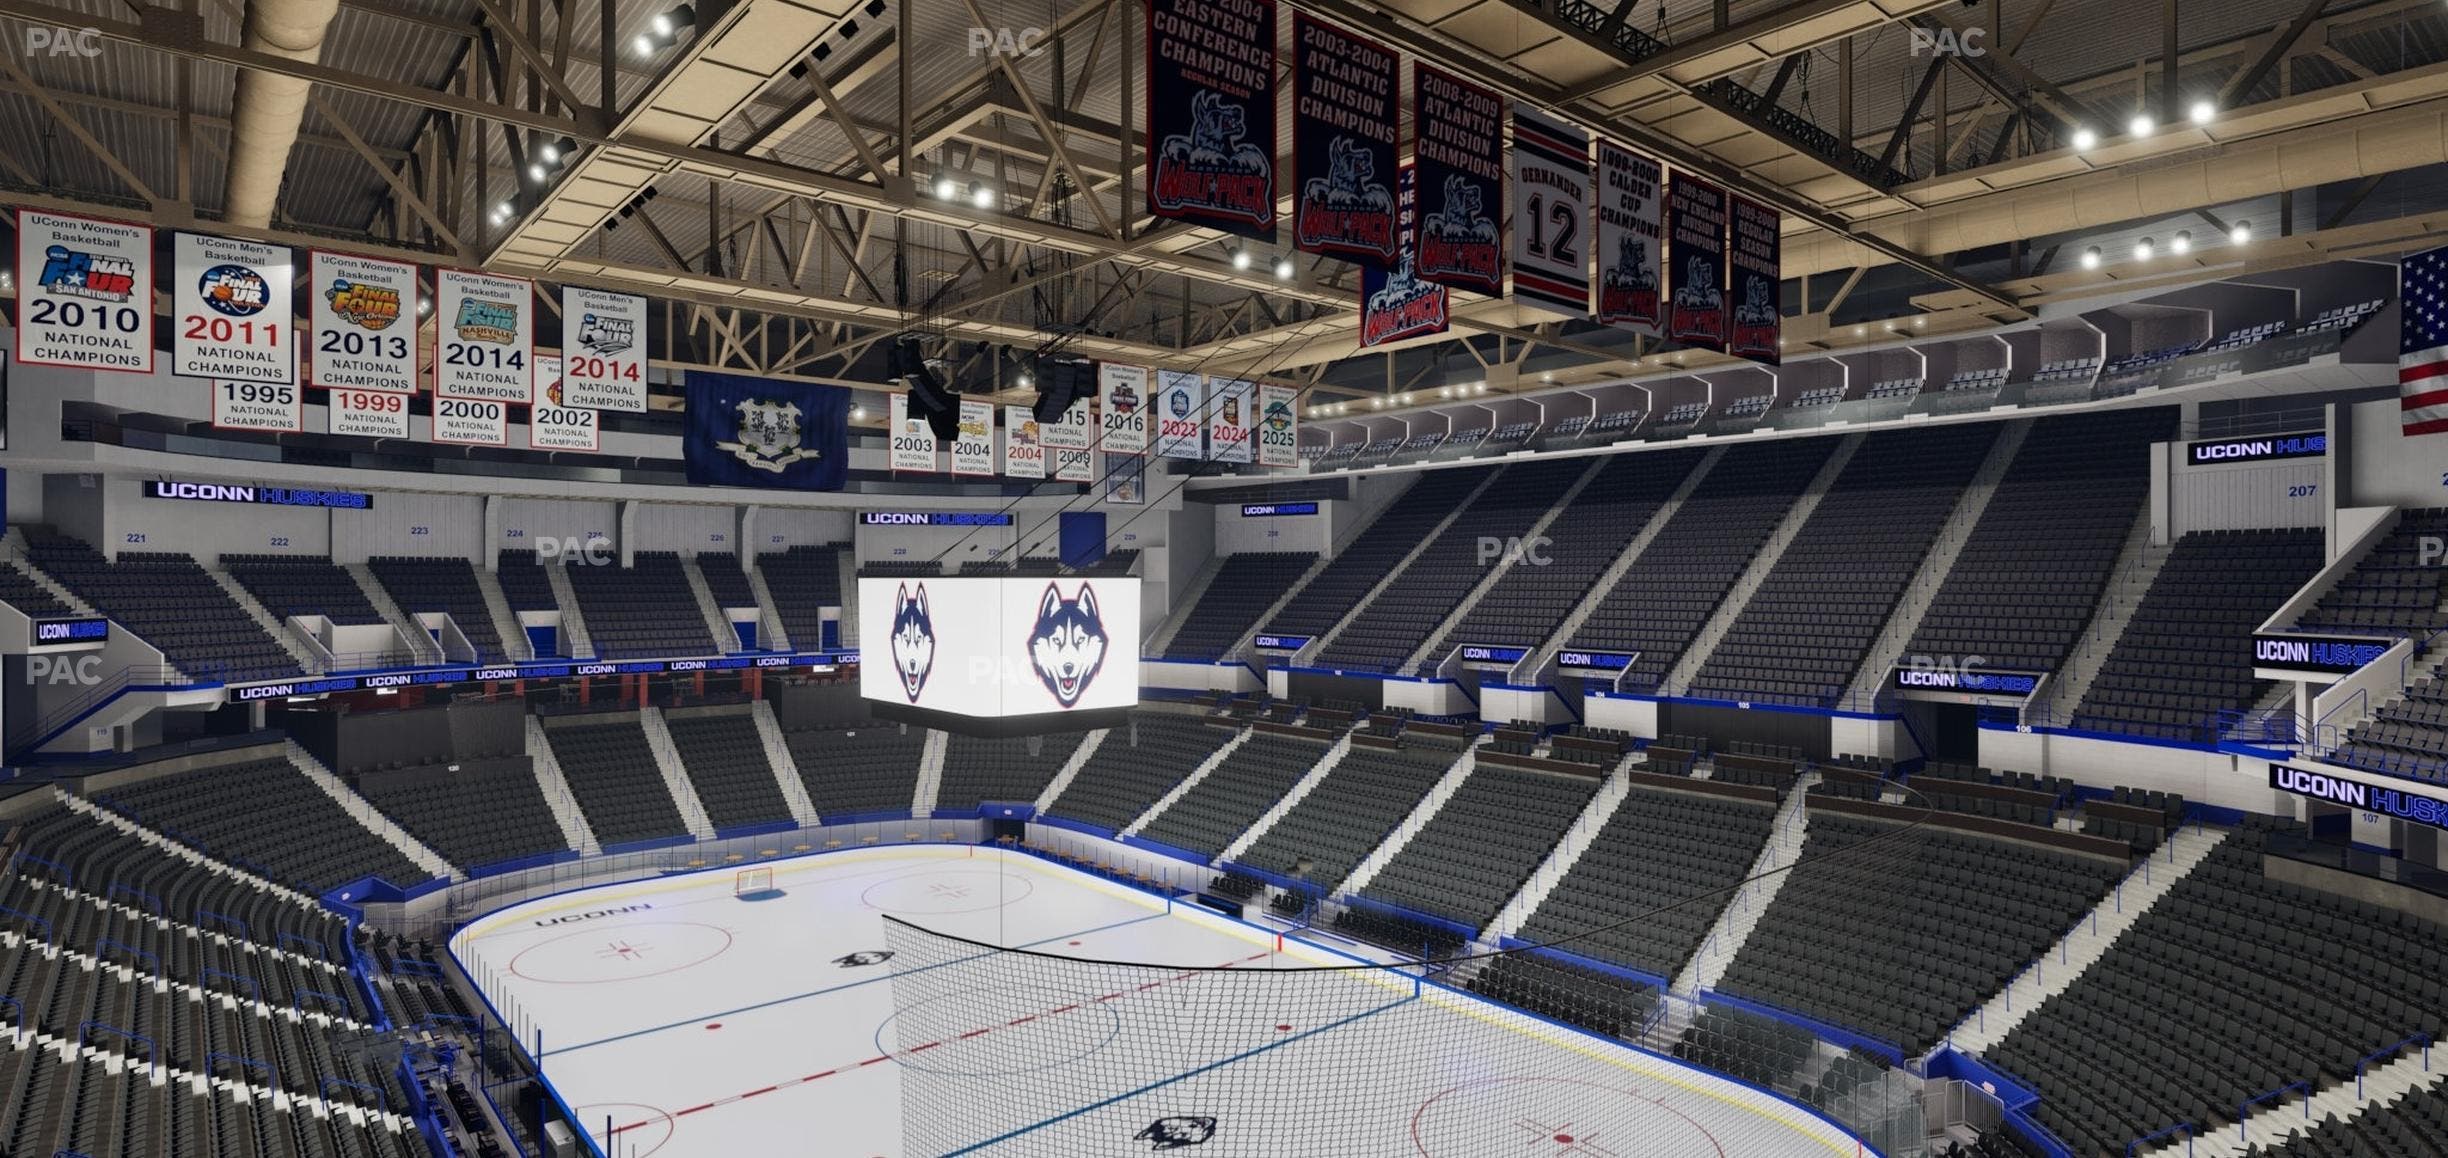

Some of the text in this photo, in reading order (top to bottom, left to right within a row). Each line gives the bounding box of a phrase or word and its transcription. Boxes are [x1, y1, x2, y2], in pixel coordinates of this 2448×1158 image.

[1174, 0, 1257, 42] EASTERN
[1153, 11, 1271, 70] CONFERENCE
[1304, 25, 1391, 75] 2003-2004
[1161, 38, 1266, 91] CHAMPIONS
[1307, 50, 1389, 96] ATLANTIC
[1311, 75, 1384, 117] DIVISION
[1423, 74, 1498, 118] 2008-2009
[1300, 96, 1395, 144] CHAMPIONS
[1424, 96, 1494, 136] ATLANTIC
[1428, 119, 1490, 156] DIVISION
[1419, 137, 1500, 180] CHAMPIONS
[1609, 170, 1652, 200] CALDER
[1620, 193, 1641, 214] CUP
[31, 216, 140, 238] UConn Women's
[1527, 192, 1578, 269] 12
[1600, 206, 1660, 239] CHAMPIONS
[52, 231, 120, 248] Basketball
[196, 238, 272, 255] UConn Men's
[205, 250, 265, 265] Basketball
[321, 256, 408, 275] UConn Women's
[220, 274, 262, 291] FINAL
[337, 269, 392, 284] Basketball
[446, 273, 524, 290] UConn Women's
[55, 284, 120, 301] SAN ANTONIO
[352, 285, 398, 303] FINAL
[461, 286, 510, 299] Basketball
[578, 290, 633, 304] UConn Men's
[335, 291, 398, 317] FOUR
[584, 302, 627, 313] Basketball
[30, 299, 140, 333] 2010
[596, 317, 633, 332] FINAL
[184, 315, 277, 347] 2011
[463, 327, 510, 339] NASHVILLE
[44, 332, 133, 349] NATIONAL
[321, 330, 408, 359] 2013
[34, 347, 142, 366] CHAMPIONS
[197, 346, 275, 363] NATIONAL
[446, 343, 524, 371] 2014
[188, 361, 283, 379] CHAMPIONS
[332, 359, 402, 374] NATIONAL
[570, 356, 640, 382] 2014
[323, 373, 409, 389] CHAMPIONS
[456, 371, 519, 385] NATIONAL
[224, 383, 293, 405] 1995
[449, 384, 525, 399] CHAMPIONS
[579, 382, 635, 396] NATIONAL
[339, 392, 401, 413] 1999
[572, 394, 640, 409] CHAMPIONS
[231, 405, 289, 417] NATIONAL
[344, 413, 397, 425] NATIONAL
[440, 401, 499, 420] 2000
[537, 408, 592, 427] 2002
[224, 416, 294, 429] CHAMPIONS
[338, 423, 402, 435] CHAMPIONS
[447, 420, 496, 431] NATIONAL
[1104, 413, 1143, 431] 2016
[1162, 420, 1197, 437] 2023
[442, 431, 500, 442] CHAMPIONS
[544, 427, 588, 438] NATIONAL
[1048, 426, 1083, 437] NATIONAL
[1213, 425, 1247, 442] 2024
[1263, 430, 1294, 446] 2025
[539, 437, 592, 447] CHAMPIONS
[894, 437, 932, 452] 2003
[955, 442, 990, 456] 2004
[1044, 437, 1086, 447] CHAMPIONS
[2196, 440, 2272, 460] UCONN
[899, 453, 929, 461] NATIONAL
[1009, 446, 1042, 460] 2004
[1060, 450, 1091, 463] 2009
[895, 461, 932, 469] CHAMPIONS
[157, 482, 366, 509] UCONN HUSKIES
[2289, 485, 2317, 497] 207
[867, 513, 928, 524] UCONN
[1244, 506, 1275, 515] UCONN
[127, 533, 146, 543] 221
[411, 526, 429, 536] 223
[507, 529, 524, 538] 224
[270, 537, 289, 547] 222
[39, 623, 70, 640] UCONN
[1256, 637, 1279, 646] UCONN
[1463, 647, 1491, 659] UCONN
[1560, 652, 1591, 665] UCONN
[2256, 640, 2309, 662] UCONN
[240, 684, 293, 700] UCONN
[366, 675, 411, 688] UCONN
[476, 669, 517, 680] UCONN
[578, 665, 616, 674] UCONN
[671, 661, 706, 670] UCONN
[756, 657, 790, 666] UCONN
[1900, 671, 1955, 687] UCONN
[2277, 767, 2448, 827] UCONN HUSK
[2361, 812, 2379, 824] 107
[535, 903, 653, 927] UCONN
